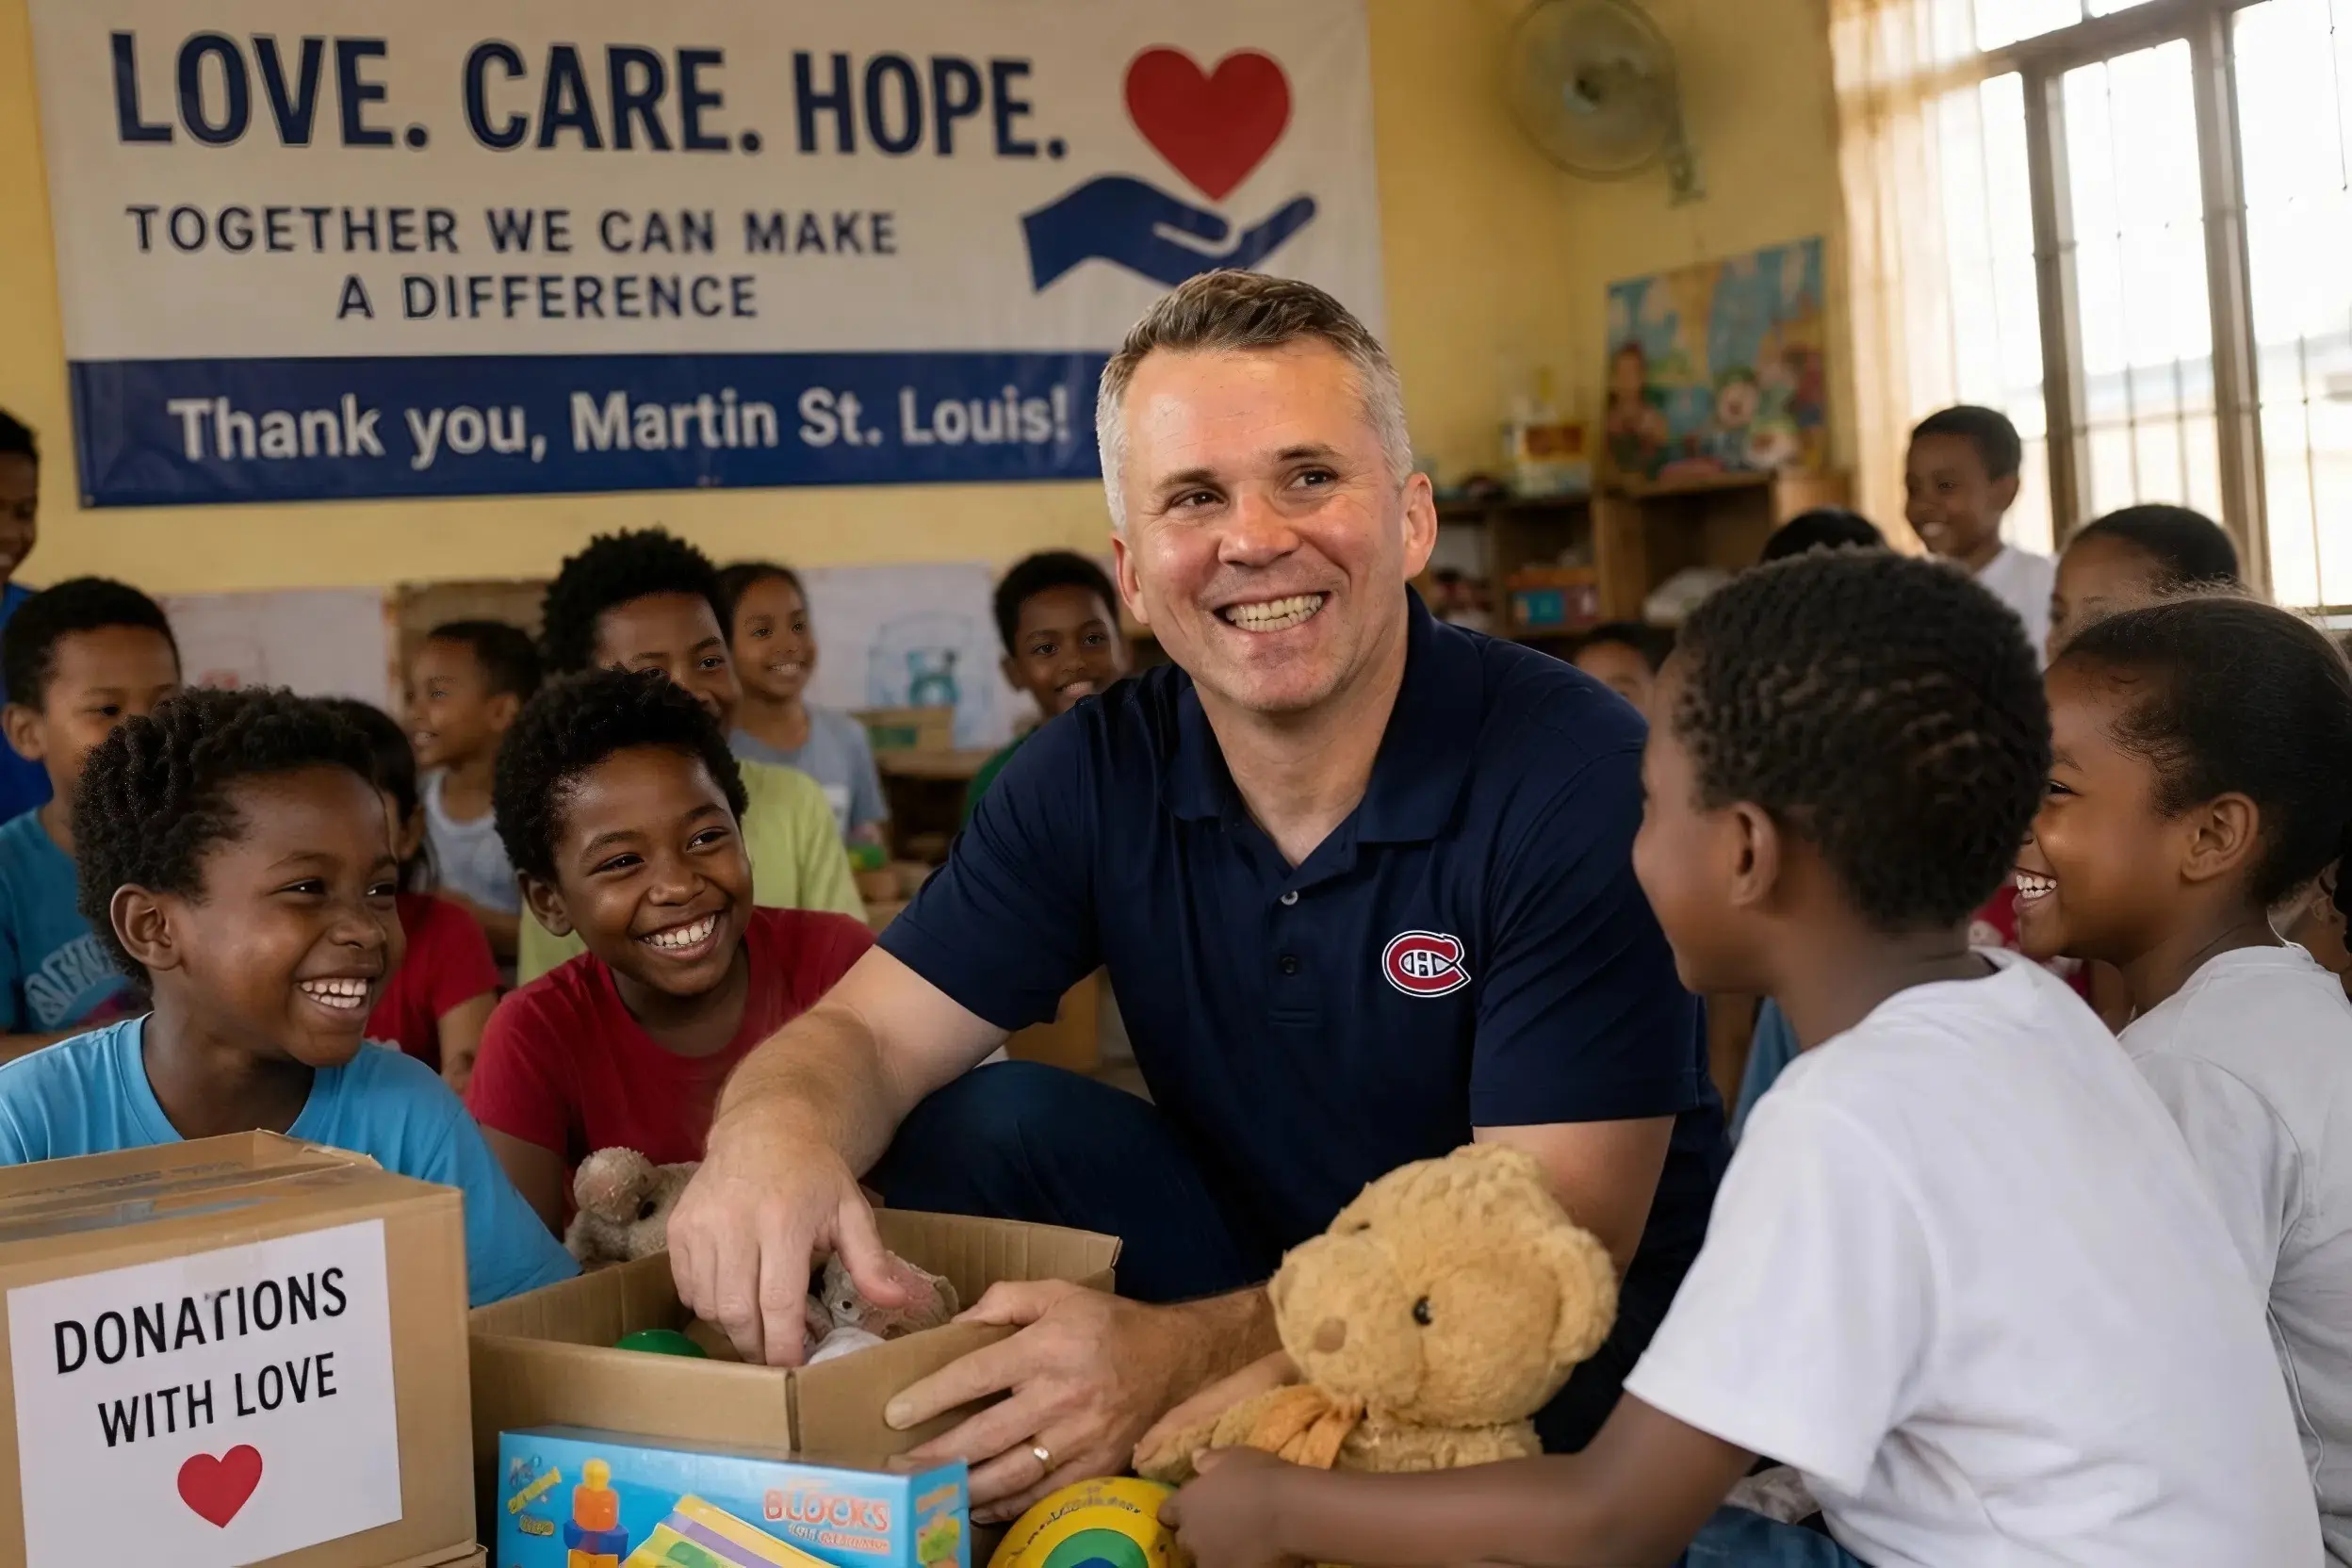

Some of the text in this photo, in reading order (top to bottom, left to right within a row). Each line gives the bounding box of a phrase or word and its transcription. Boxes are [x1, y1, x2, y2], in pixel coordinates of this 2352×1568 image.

[110, 29, 1068, 158] LOVE. CARE. HOPE.
[126, 204, 897, 255] TOGETHER WE CAN MAKE
[336, 274, 757, 320] A DIFFERENCE
[168, 383, 1070, 472] Thank you, Martin St. Louis!
[54, 1266, 348, 1376] DONATIONS
[97, 1350, 338, 1448] WITH LOVE
[763, 1489, 891, 1533] BLOCKS
